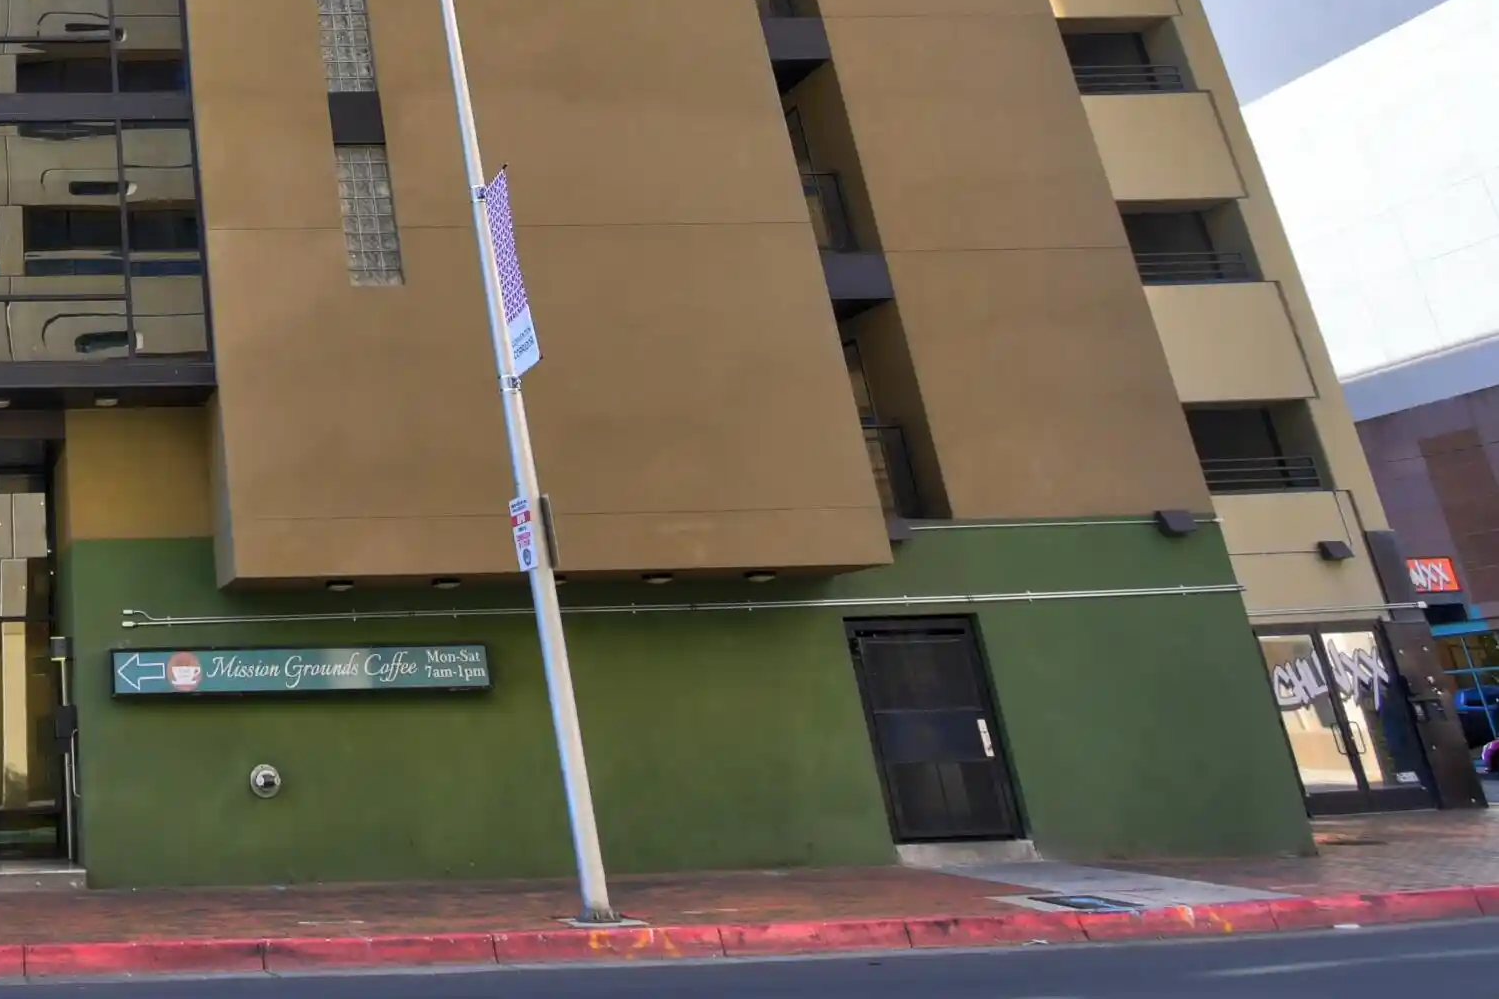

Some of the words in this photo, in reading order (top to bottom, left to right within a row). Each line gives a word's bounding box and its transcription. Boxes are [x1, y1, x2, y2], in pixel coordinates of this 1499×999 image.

[426, 648, 481, 664] Mon-Sat
[206, 655, 281, 679] Mission
[284, 651, 360, 689] Grounds
[363, 651, 418, 683] Coffee
[425, 664, 487, 681] 7am-1pm
